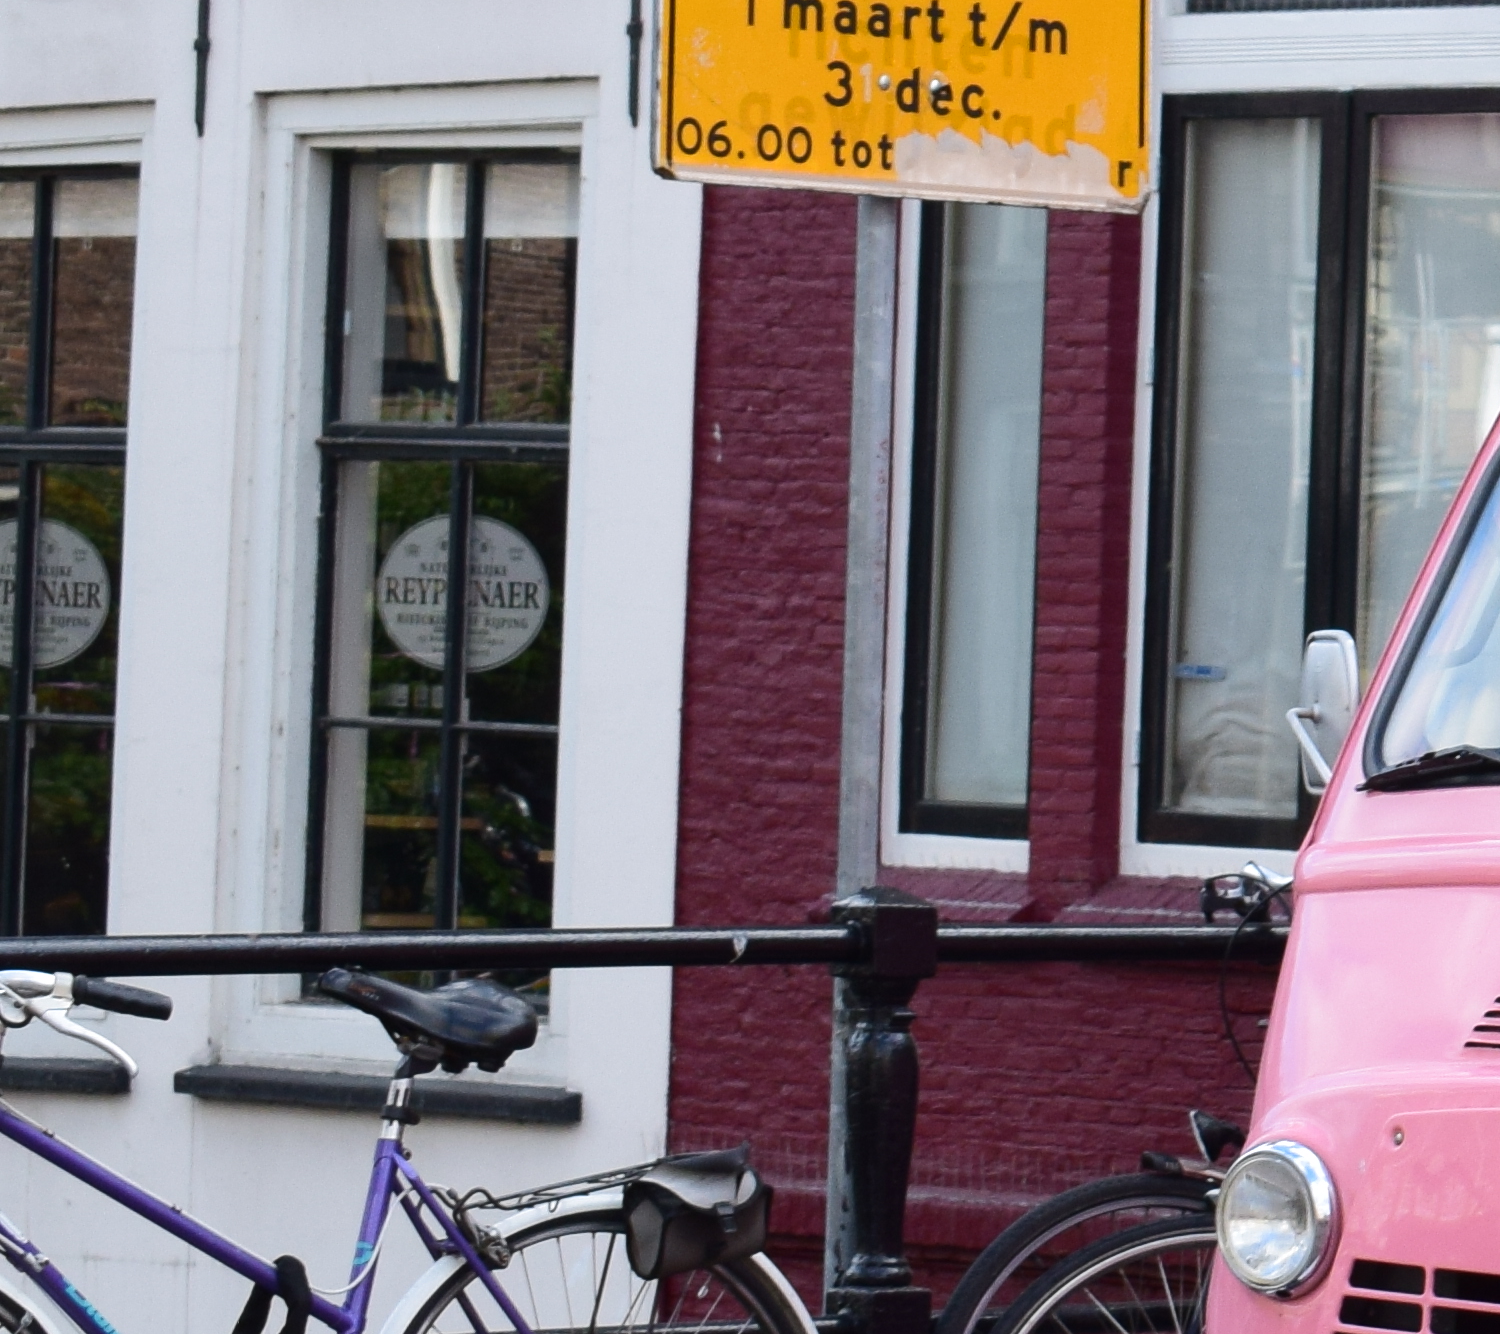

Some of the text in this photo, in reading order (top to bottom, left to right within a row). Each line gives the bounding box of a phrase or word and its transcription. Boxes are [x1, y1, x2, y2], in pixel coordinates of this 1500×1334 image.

[967, 2, 1069, 55] t/m
[895, 68, 1003, 120] dec.
[676, 117, 812, 164] 06.00
[832, 131, 893, 169] tot
[0, 579, 102, 609] PNAER
[384, 576, 540, 610] REYPNAER
